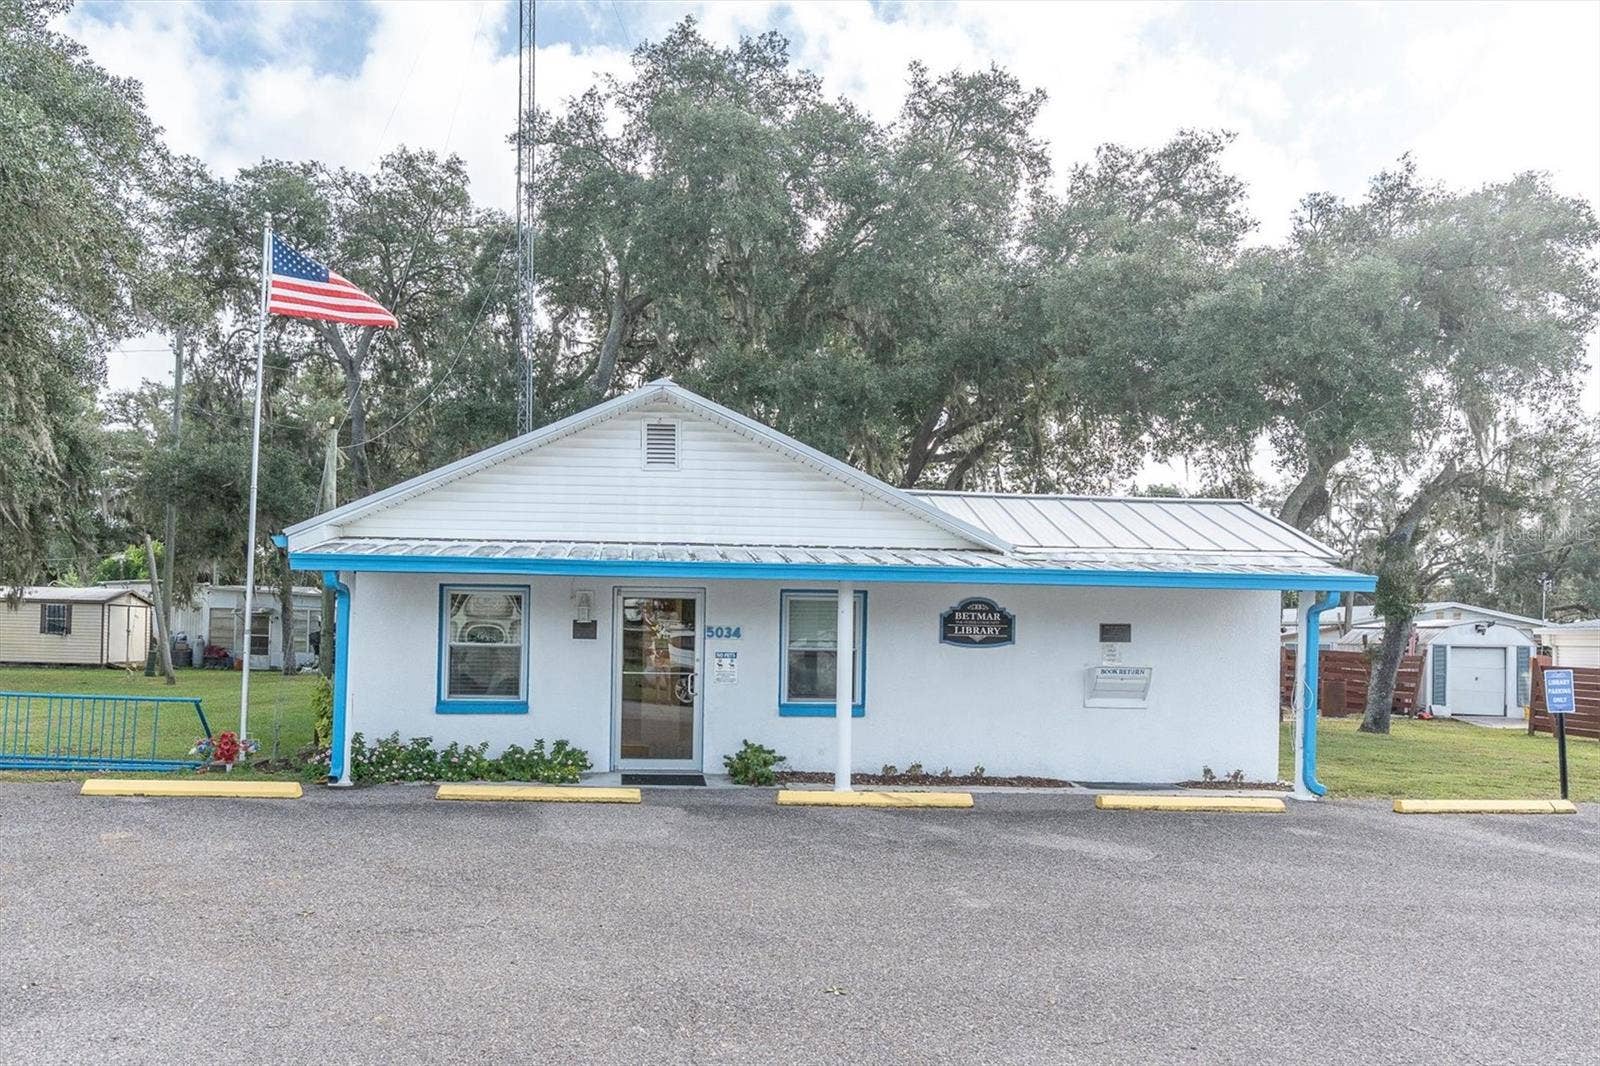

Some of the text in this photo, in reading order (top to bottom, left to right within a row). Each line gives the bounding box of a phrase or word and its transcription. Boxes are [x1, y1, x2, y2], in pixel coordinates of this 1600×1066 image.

[955, 612, 1001, 621] BETMAR
[706, 626, 741, 639] 5034
[954, 626, 1001, 635] LIBRARY
